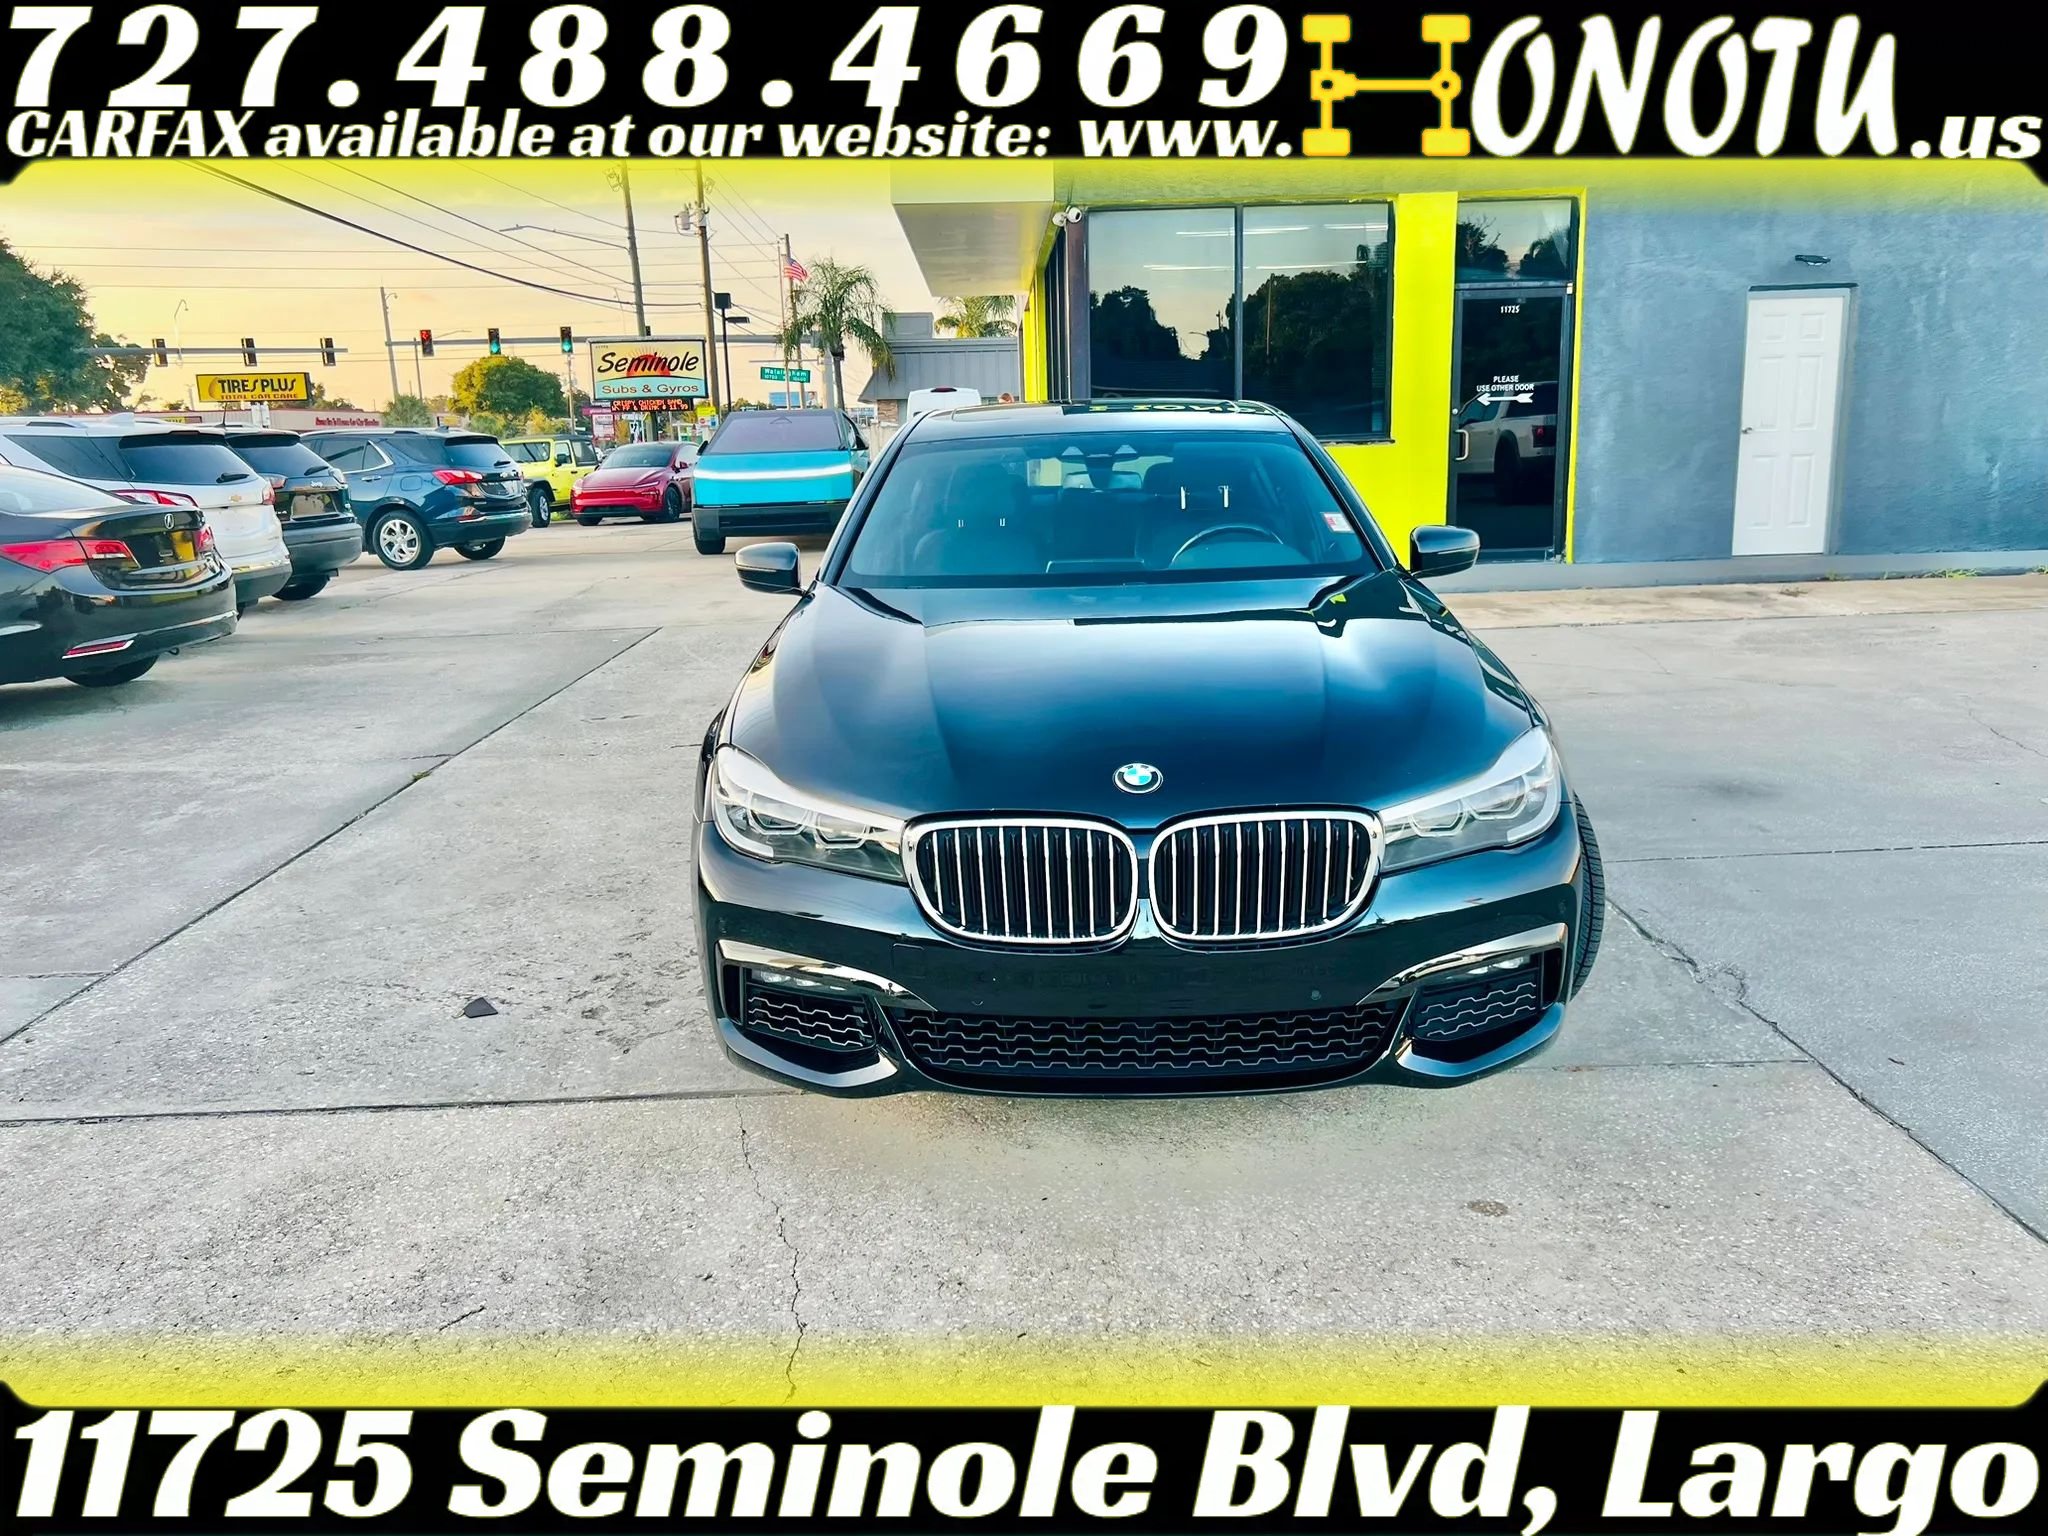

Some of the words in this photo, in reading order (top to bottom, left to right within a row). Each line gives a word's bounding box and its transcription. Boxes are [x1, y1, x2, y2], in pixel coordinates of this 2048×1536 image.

[1500, 305, 1520, 314] 11725
[597, 352, 699, 373] Seminole
[764, 368, 807, 377] Walsiham
[1493, 375, 1520, 383] PLEASE
[602, 384, 637, 394] Subs
[641, 384, 652, 393] &
[657, 384, 699, 395] Gyros
[1476, 384, 1490, 392] USE
[1491, 384, 1514, 392] OTHER
[1514, 383, 1535, 391] DOOR
